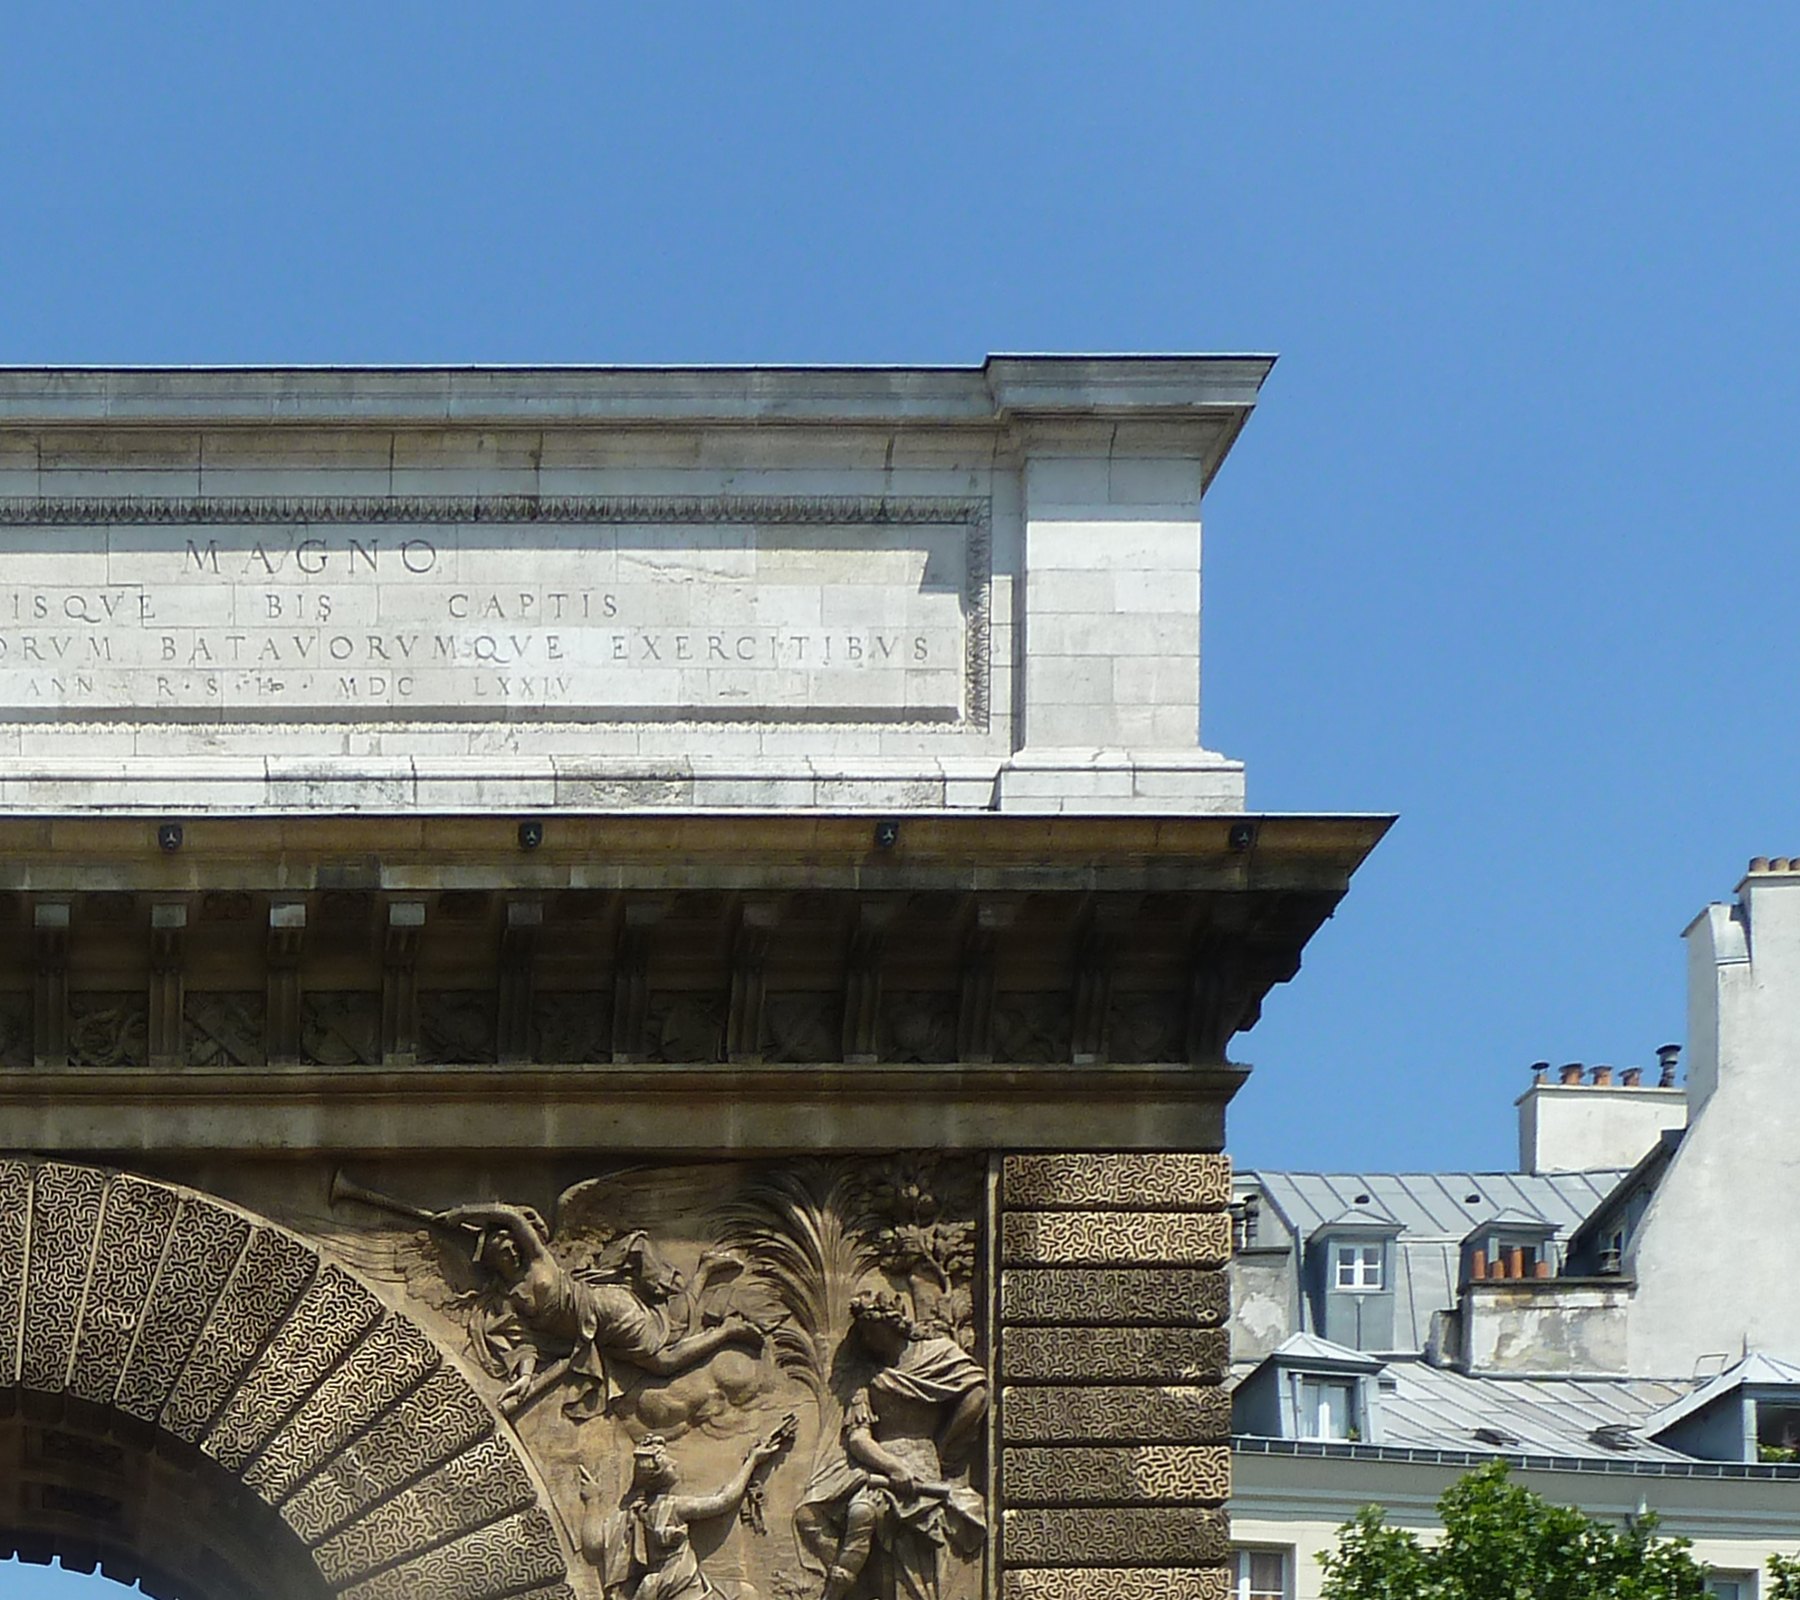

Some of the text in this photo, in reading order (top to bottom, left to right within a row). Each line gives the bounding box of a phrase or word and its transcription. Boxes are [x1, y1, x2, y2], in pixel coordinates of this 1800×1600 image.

[181, 538, 437, 575] MAGNO
[266, 593, 332, 620] BIS
[448, 593, 618, 620] CAPTIS
[611, 635, 929, 662] EXERCITIBVS
